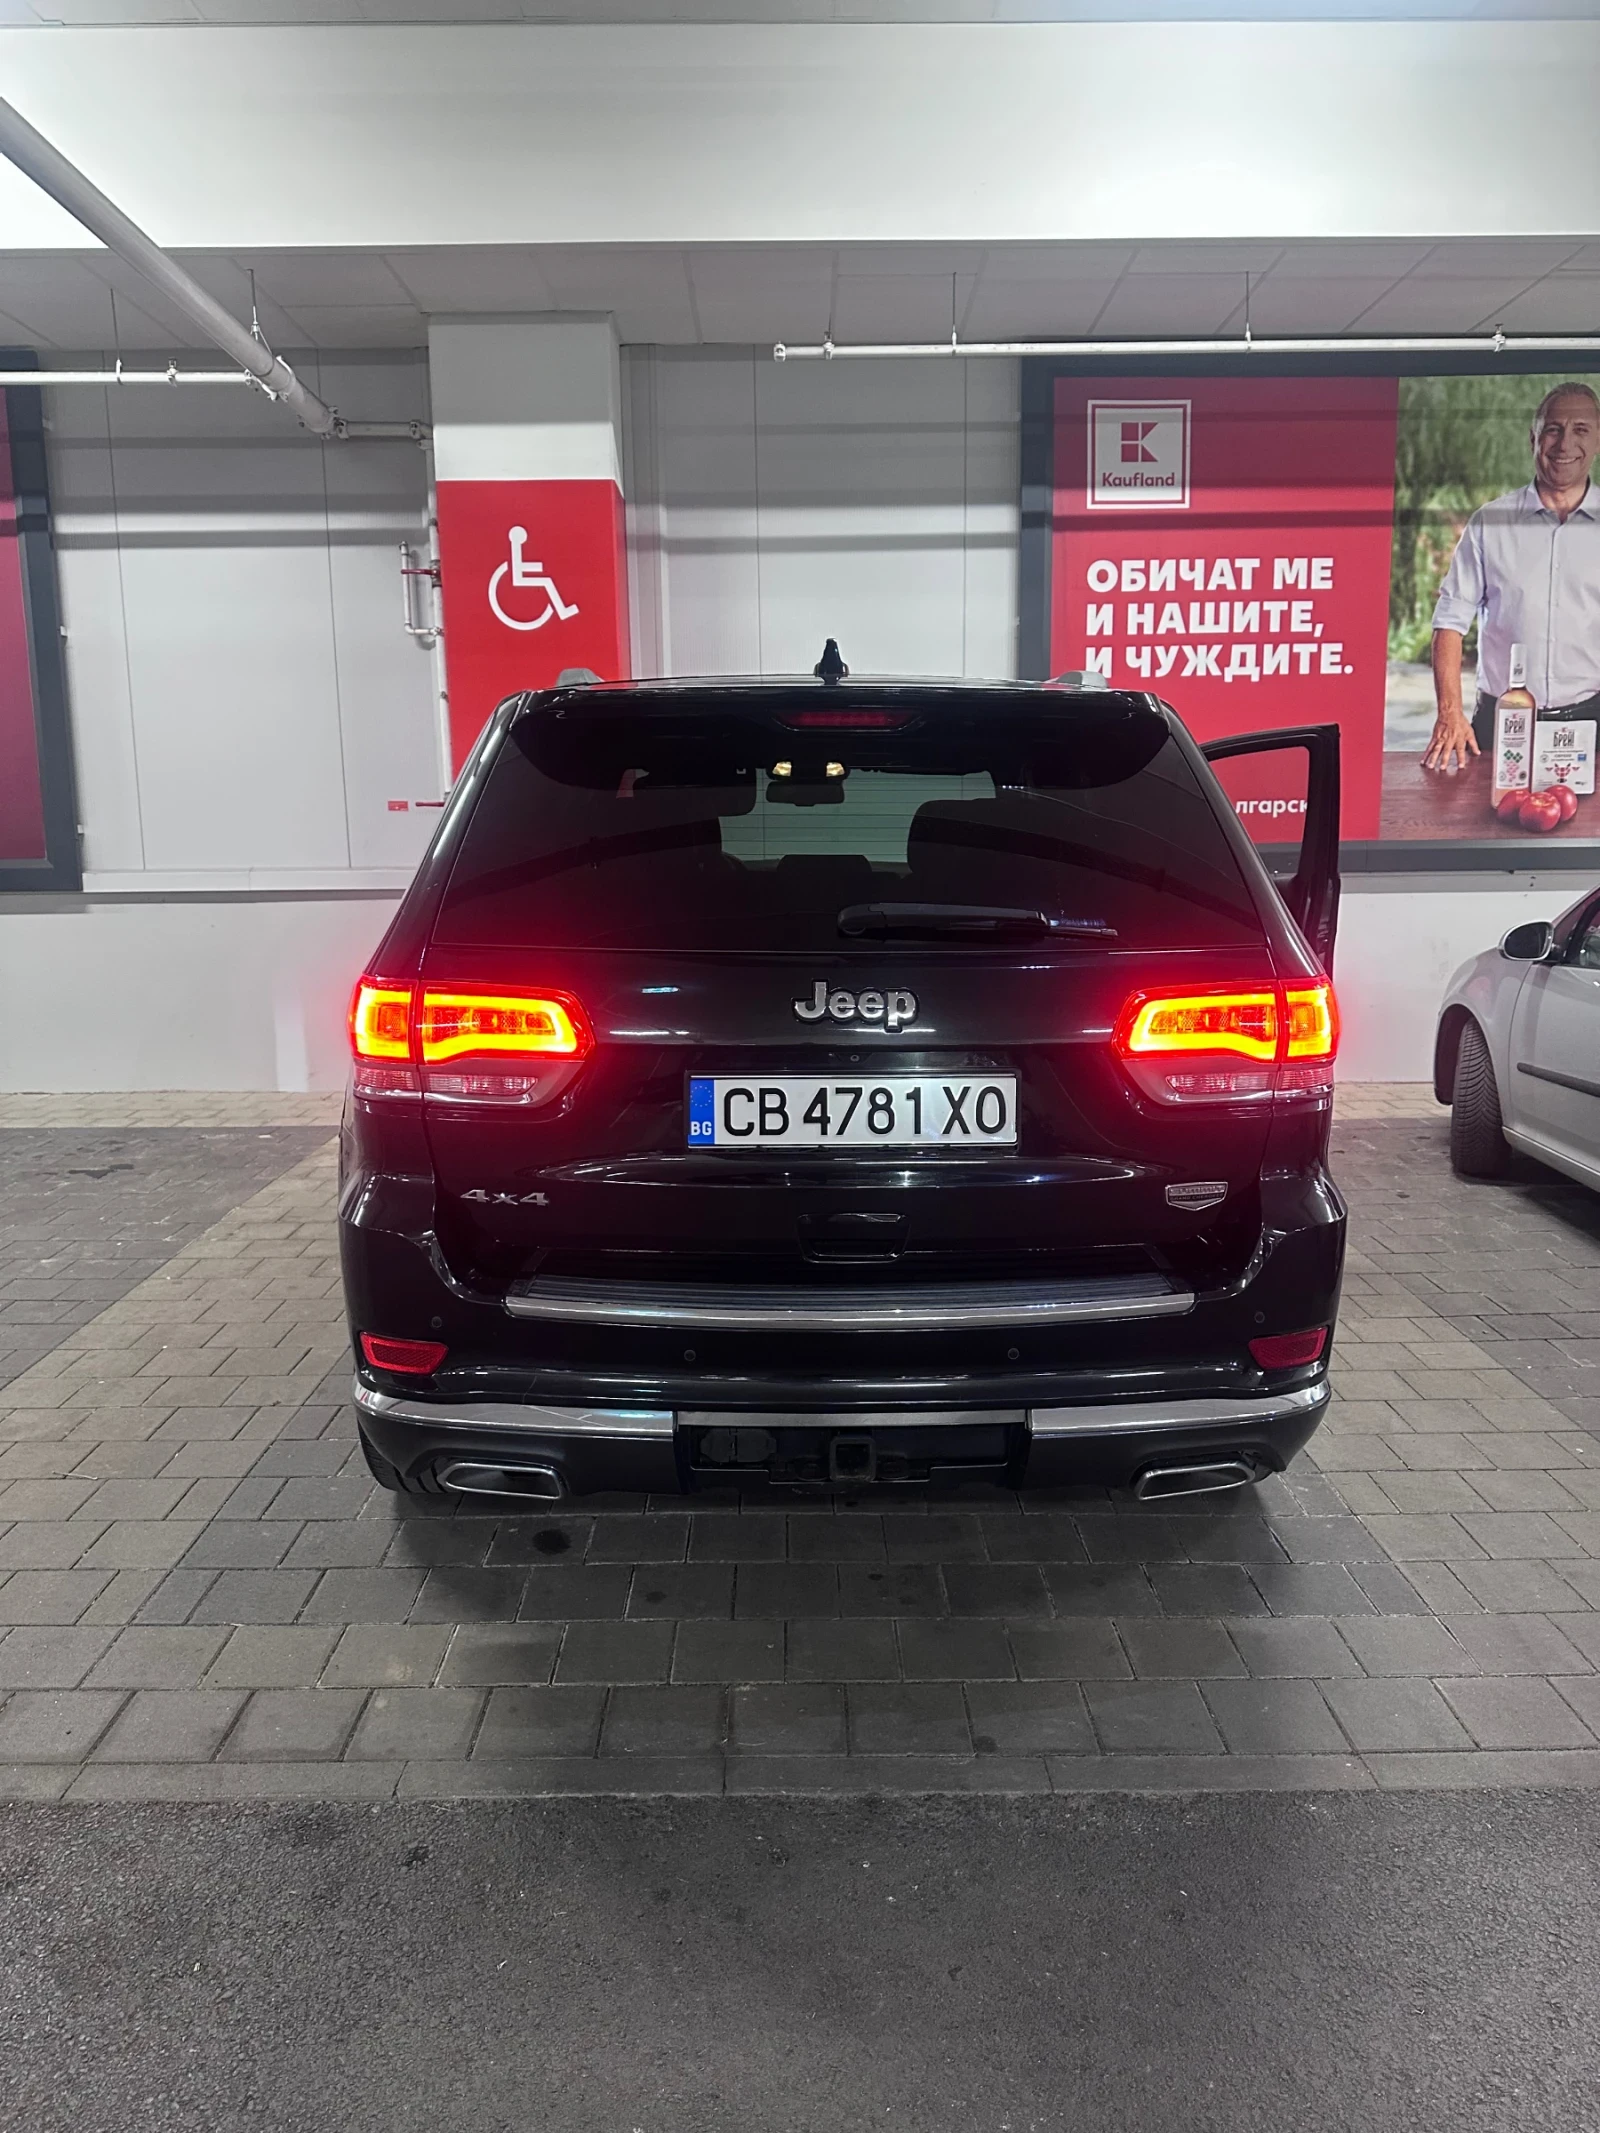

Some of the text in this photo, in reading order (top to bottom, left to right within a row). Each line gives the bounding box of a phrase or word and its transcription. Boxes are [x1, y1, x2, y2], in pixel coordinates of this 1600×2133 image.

[1102, 472, 1175, 487] Kaufland
[1086, 557, 1333, 593] ОБИЧАТ МЕ
[1086, 600, 1324, 638] И НАШИТЕ,
[1085, 643, 1354, 682] И ЧУЖДИТЕ.
[794, 980, 917, 1028] Jeep
[690, 1121, 712, 1136] BG
[723, 1087, 790, 1137] CB
[803, 1086, 924, 1136] 4781
[460, 1188, 550, 1206] 4x4
